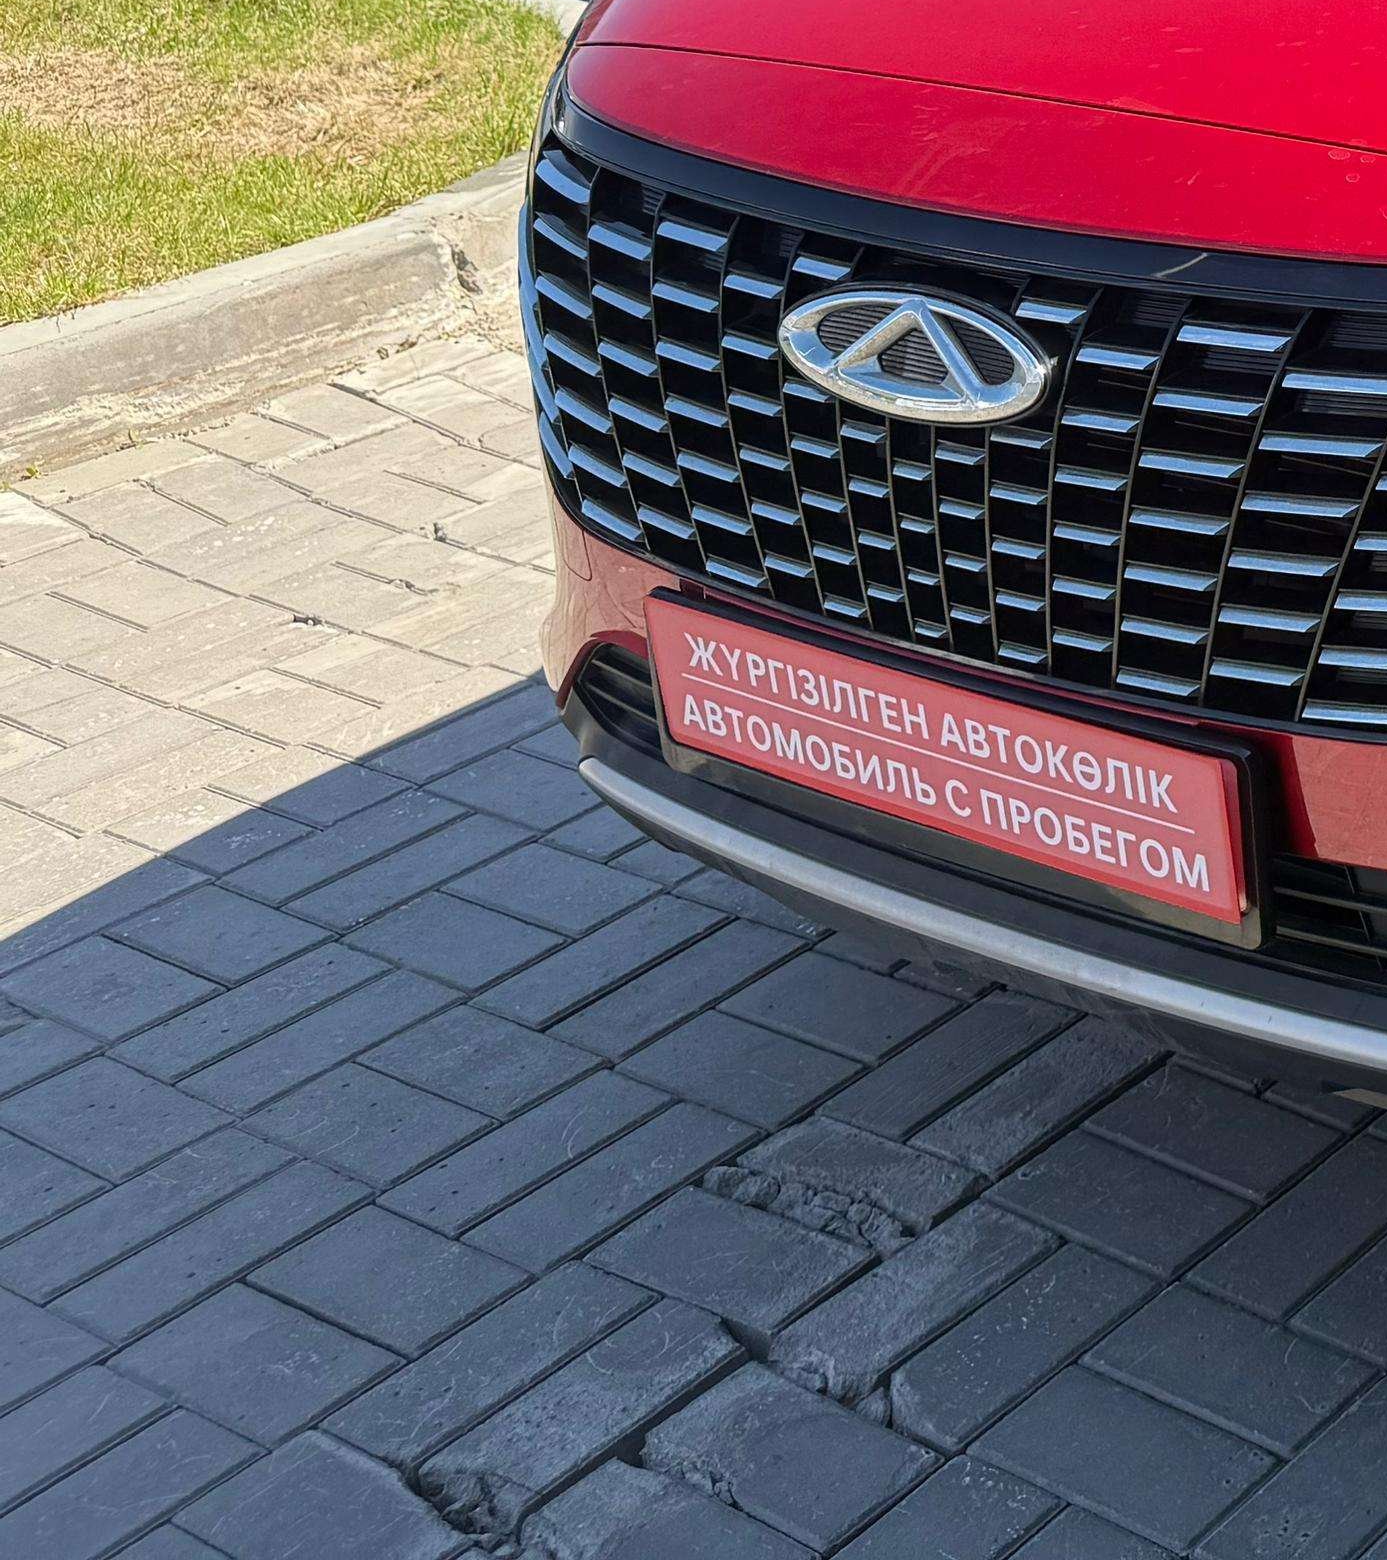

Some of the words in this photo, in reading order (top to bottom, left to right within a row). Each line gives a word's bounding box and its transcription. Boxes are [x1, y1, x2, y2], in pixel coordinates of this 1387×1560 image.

[683, 694, 937, 806] АВТОМОБИЛЬ
[945, 779, 972, 818] С
[979, 788, 1210, 892] ПРОБЕГОМ
[940, 712, 1178, 814] АВТОКӨЛІК
